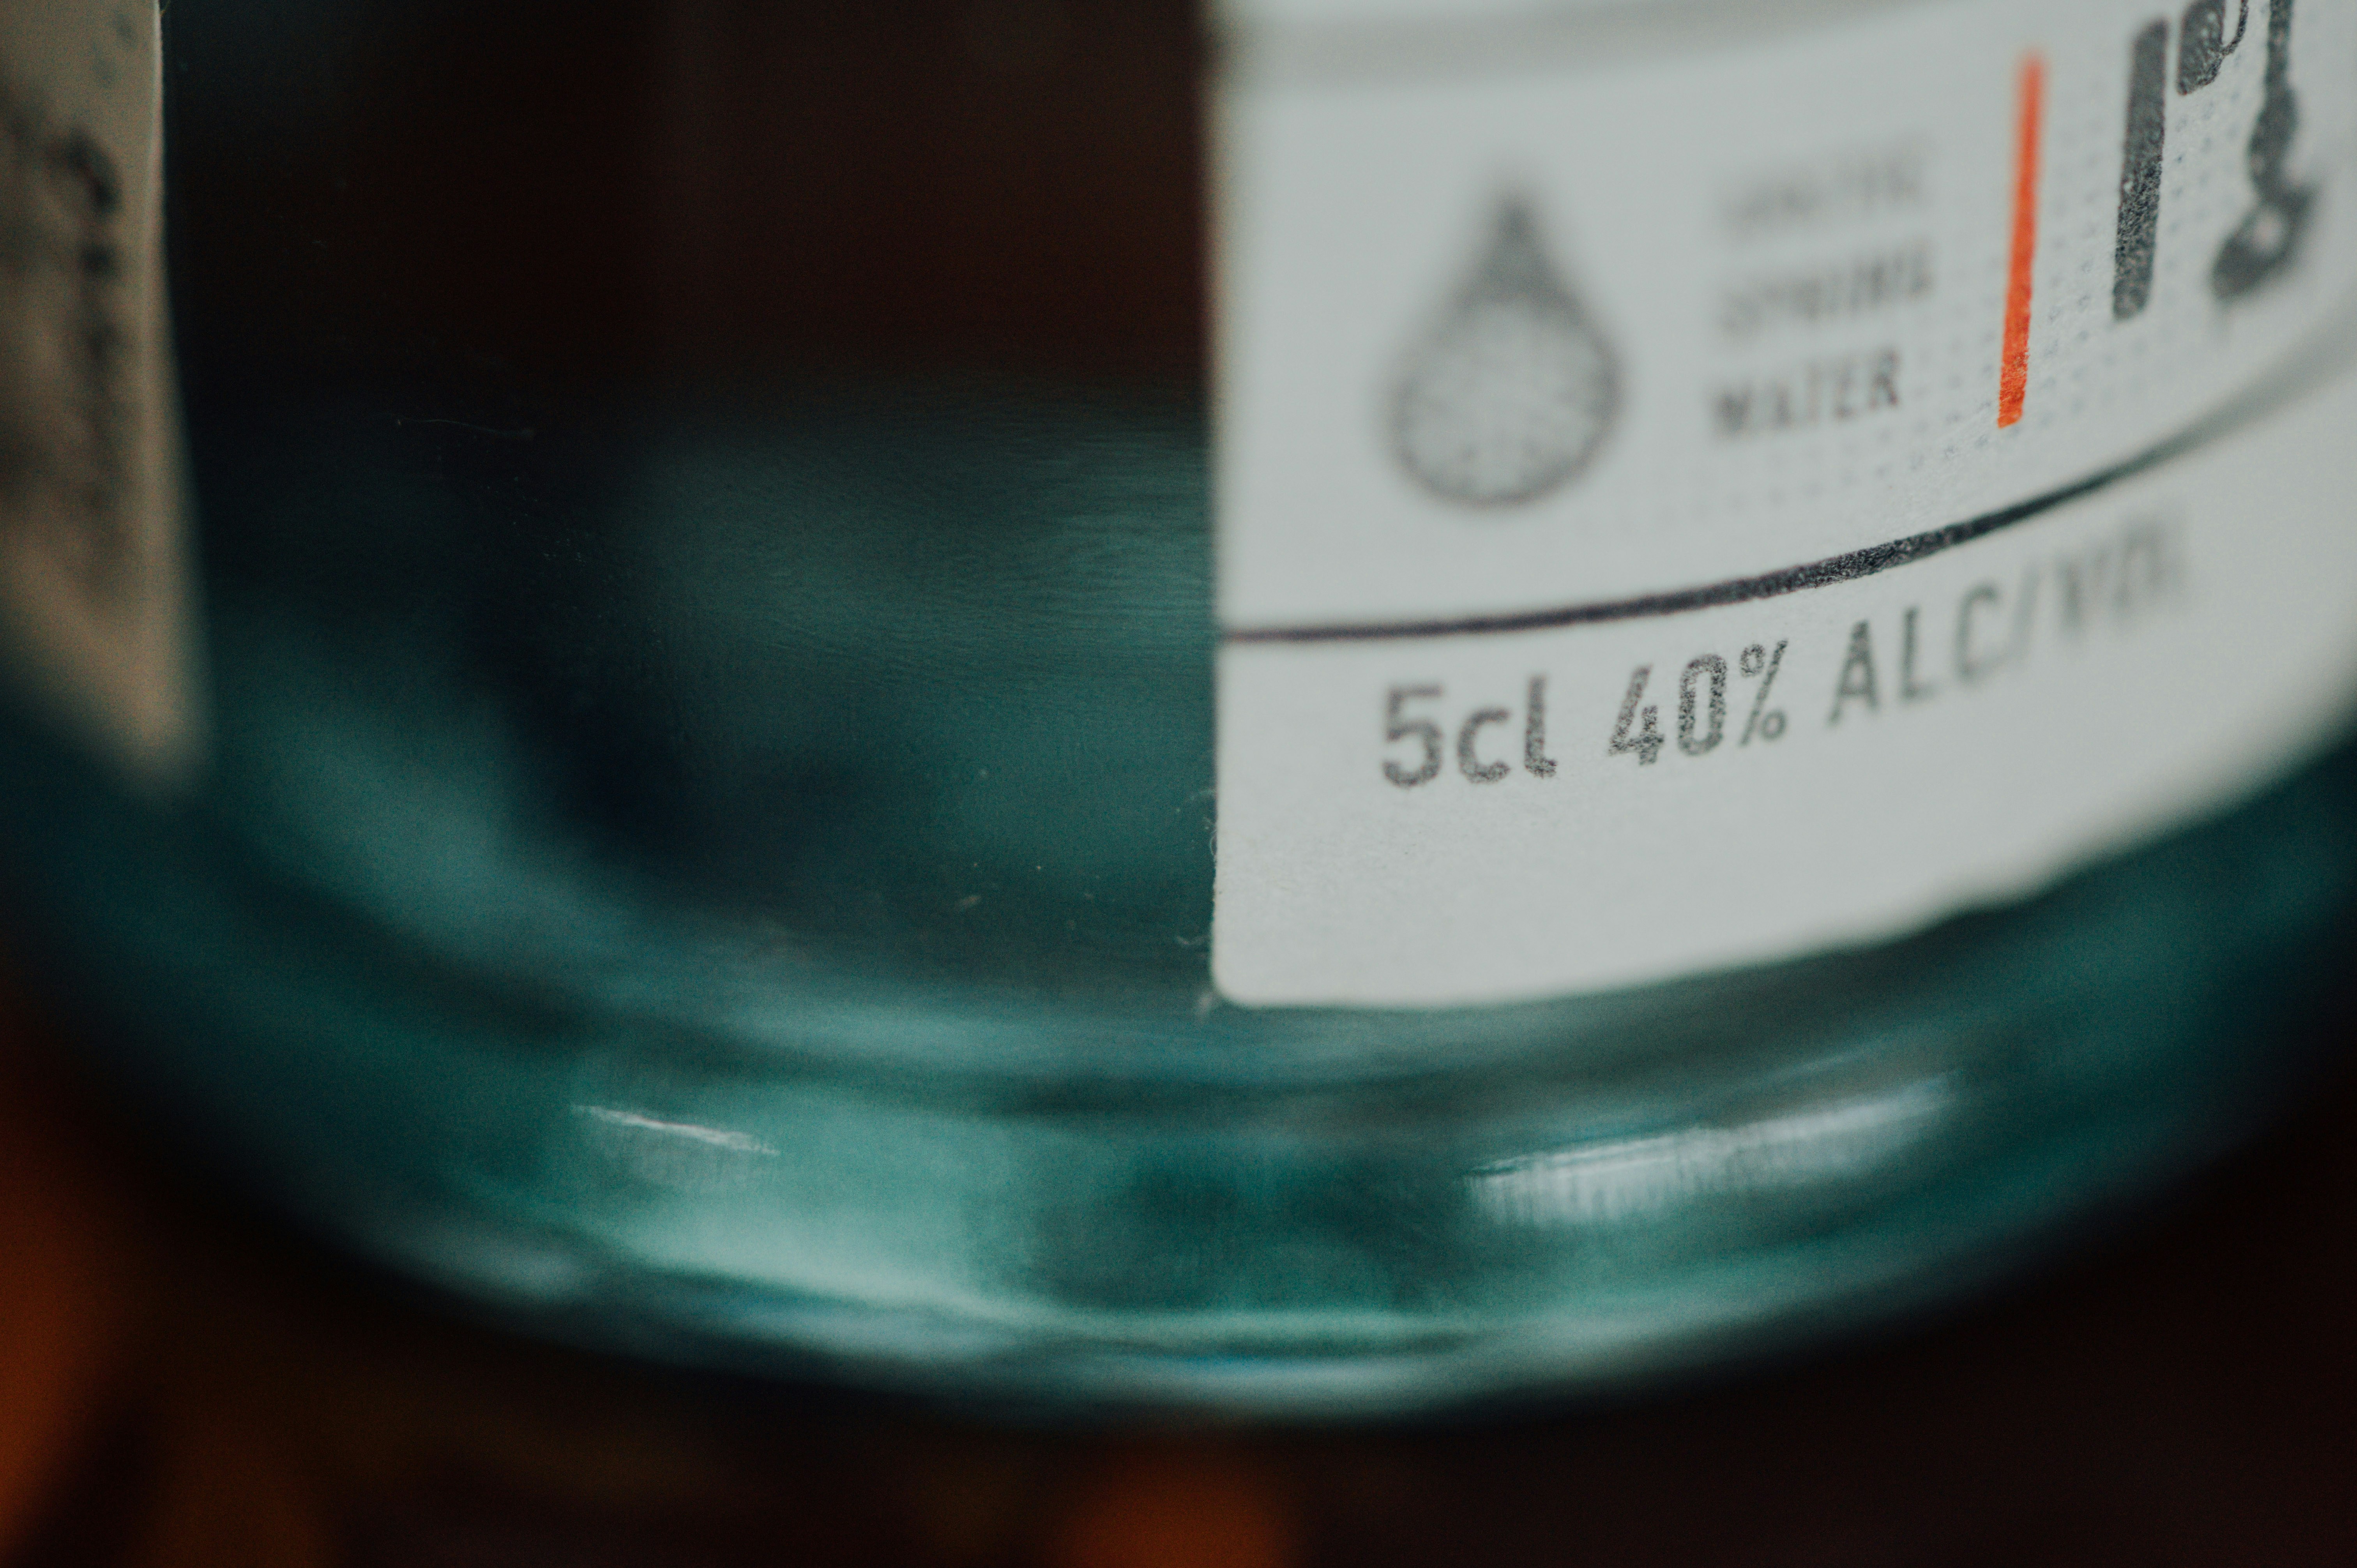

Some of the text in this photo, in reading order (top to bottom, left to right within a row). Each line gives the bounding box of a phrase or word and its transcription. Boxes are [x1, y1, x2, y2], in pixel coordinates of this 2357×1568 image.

[1710, 346, 1899, 438] WATER
[1382, 675, 1557, 788] 5cl
[1608, 639, 1788, 766] 40%
